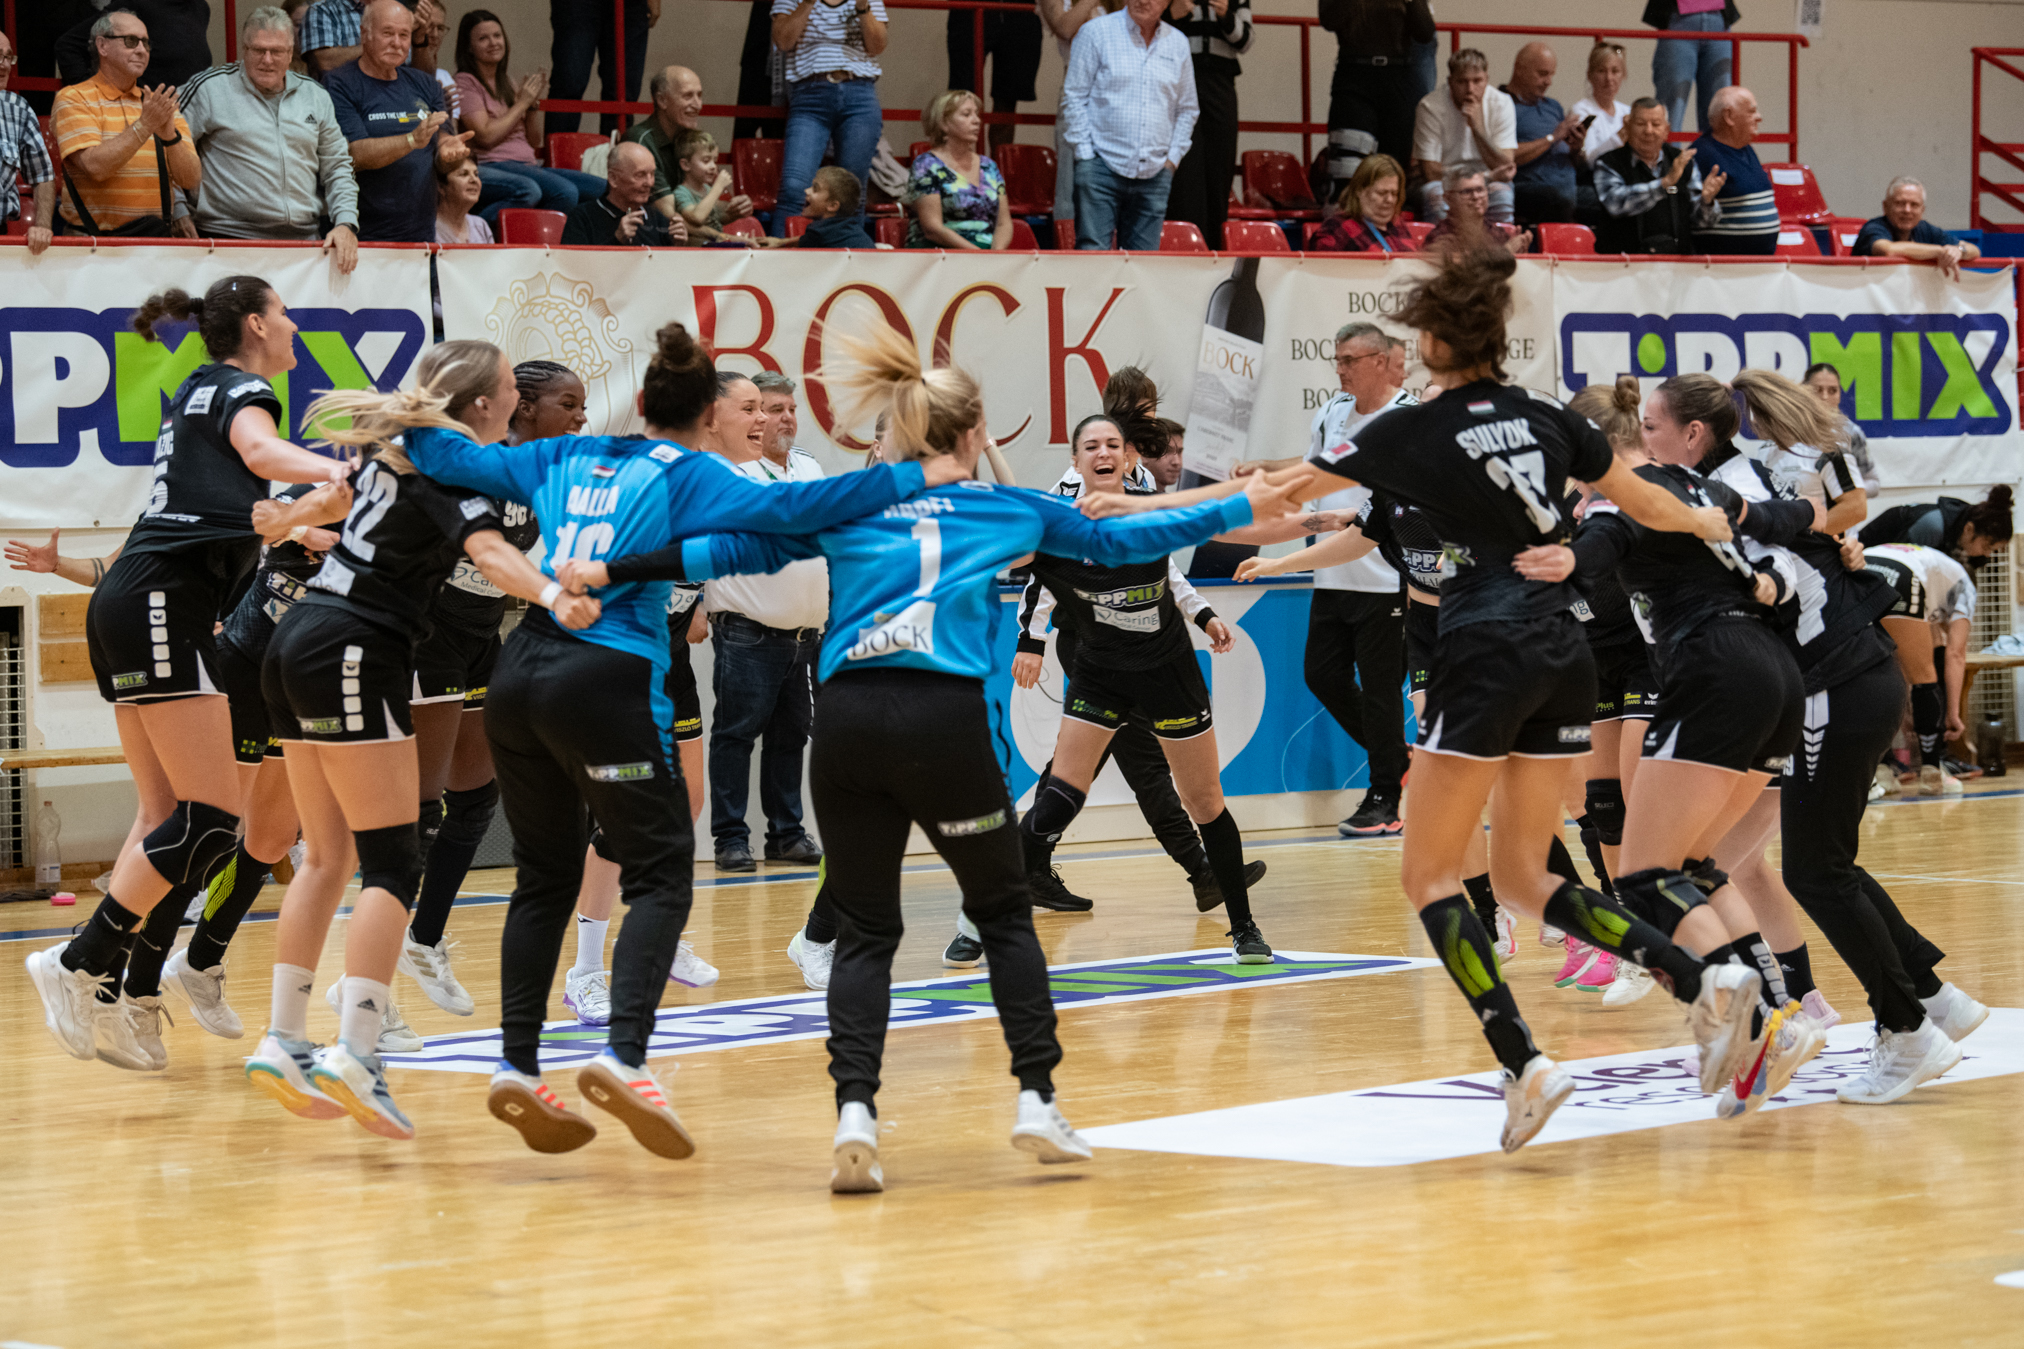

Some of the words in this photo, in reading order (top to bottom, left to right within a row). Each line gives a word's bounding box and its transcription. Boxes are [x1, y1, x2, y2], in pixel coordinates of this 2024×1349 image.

[691, 283, 1127, 452] BOCK
[1203, 340, 1256, 380] BOCK
[1291, 338, 1338, 361] BOC
[1455, 418, 1538, 460] SULYOK
[911, 518, 942, 597] 1
[1114, 611, 1159, 626] Caring
